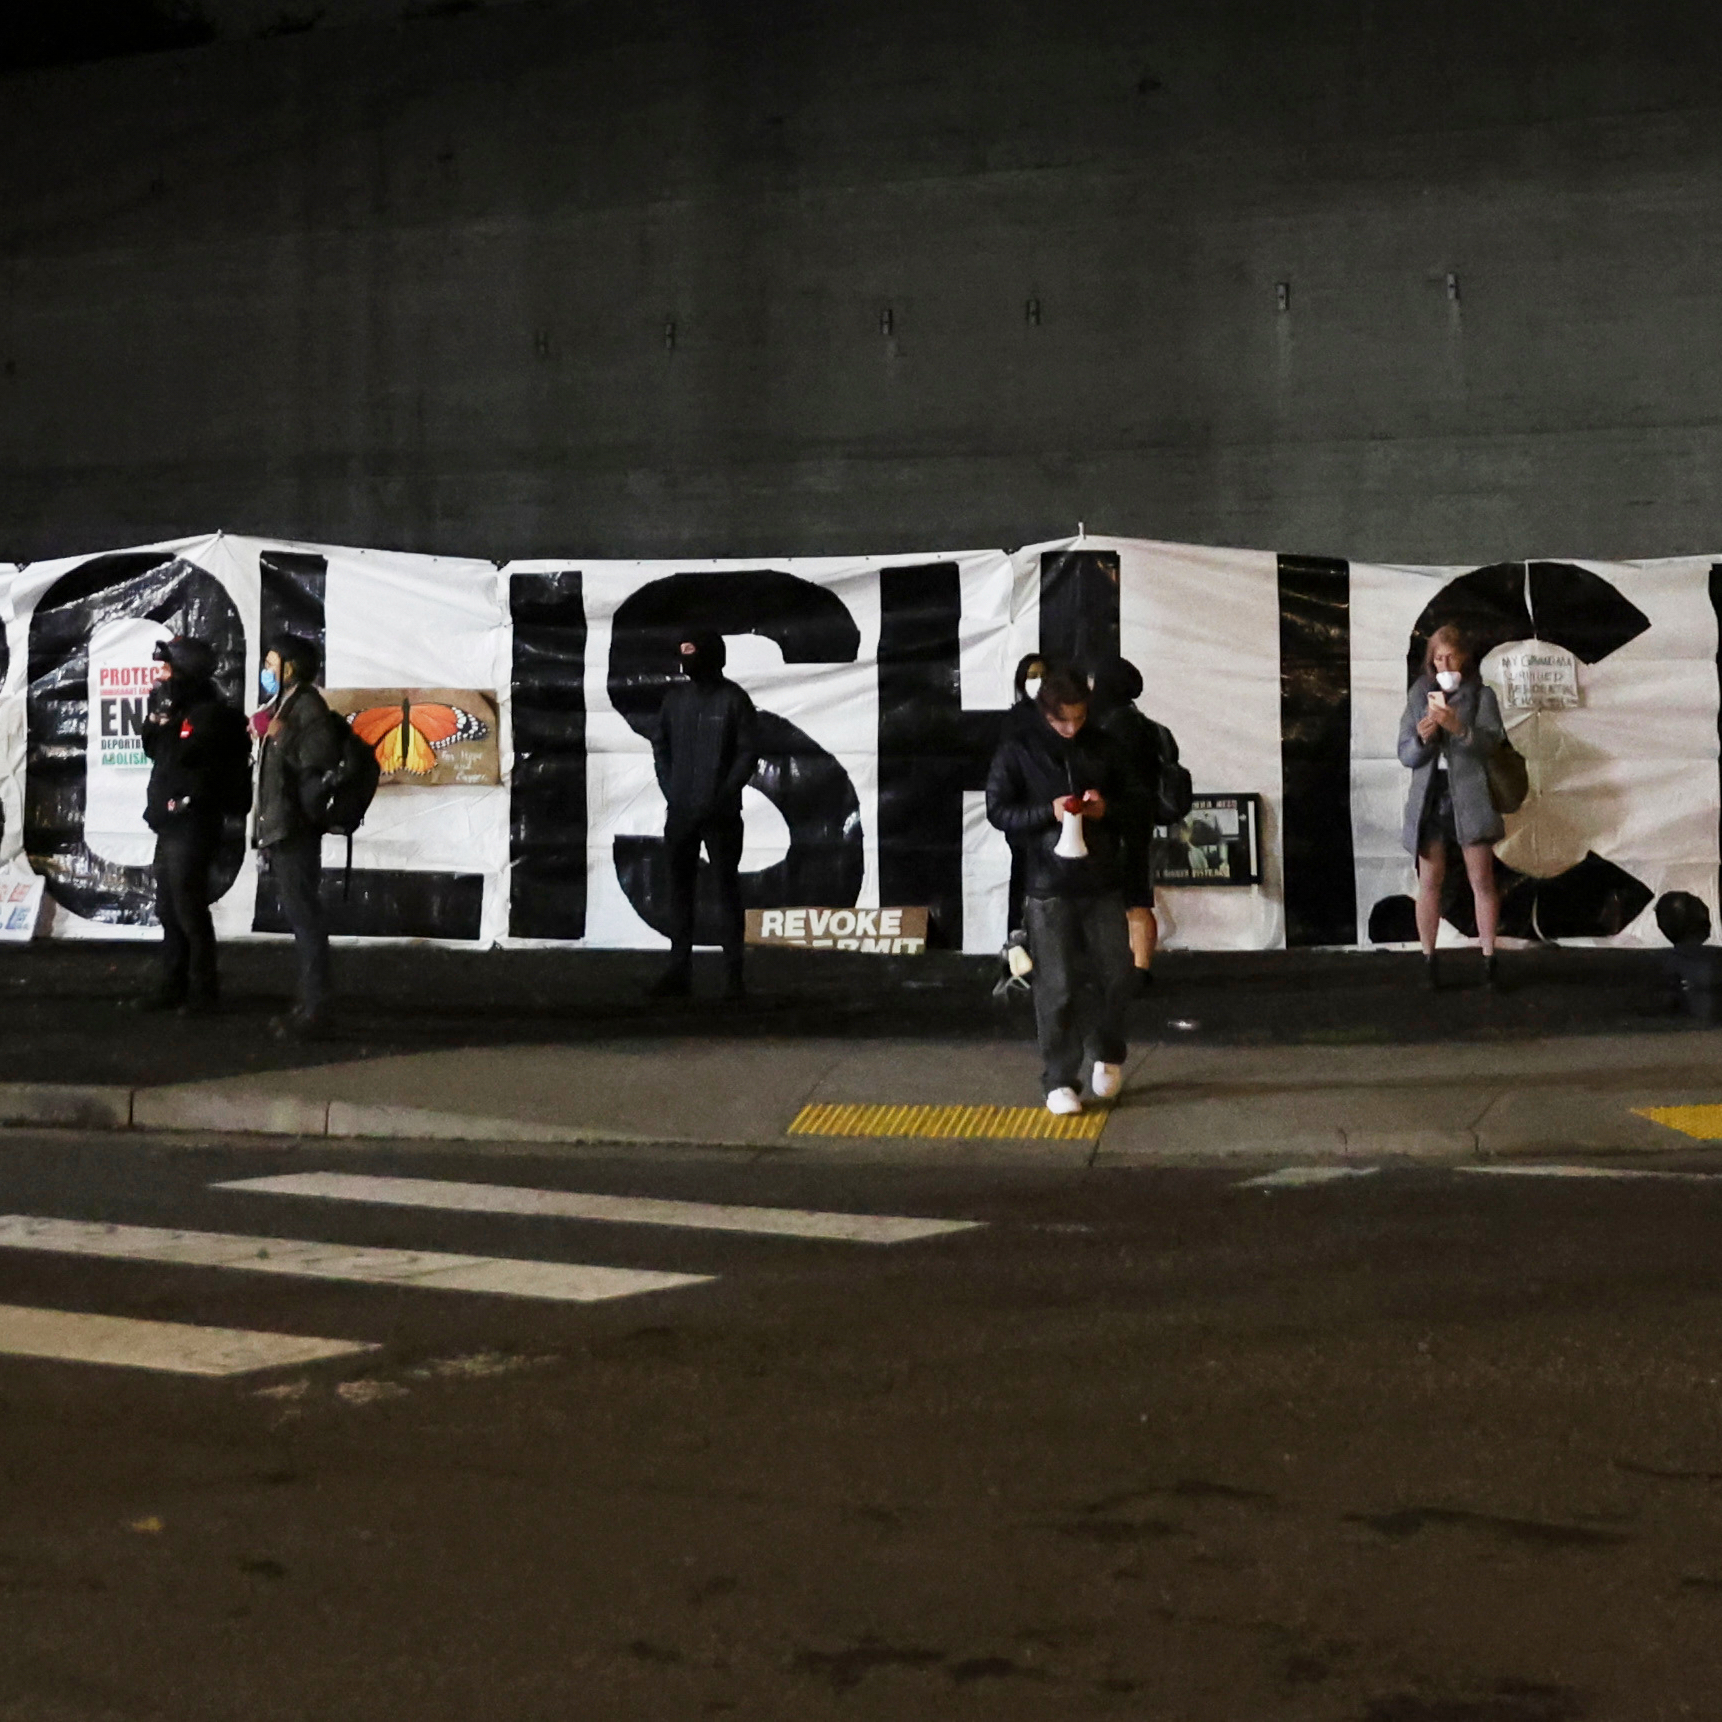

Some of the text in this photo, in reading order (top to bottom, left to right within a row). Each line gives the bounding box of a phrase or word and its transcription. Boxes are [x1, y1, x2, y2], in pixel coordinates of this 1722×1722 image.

[100, 666, 161, 686] PROTEC
[101, 697, 144, 736] EN
[761, 909, 903, 938] REVOKE
[788, 937, 925, 954] MIT
